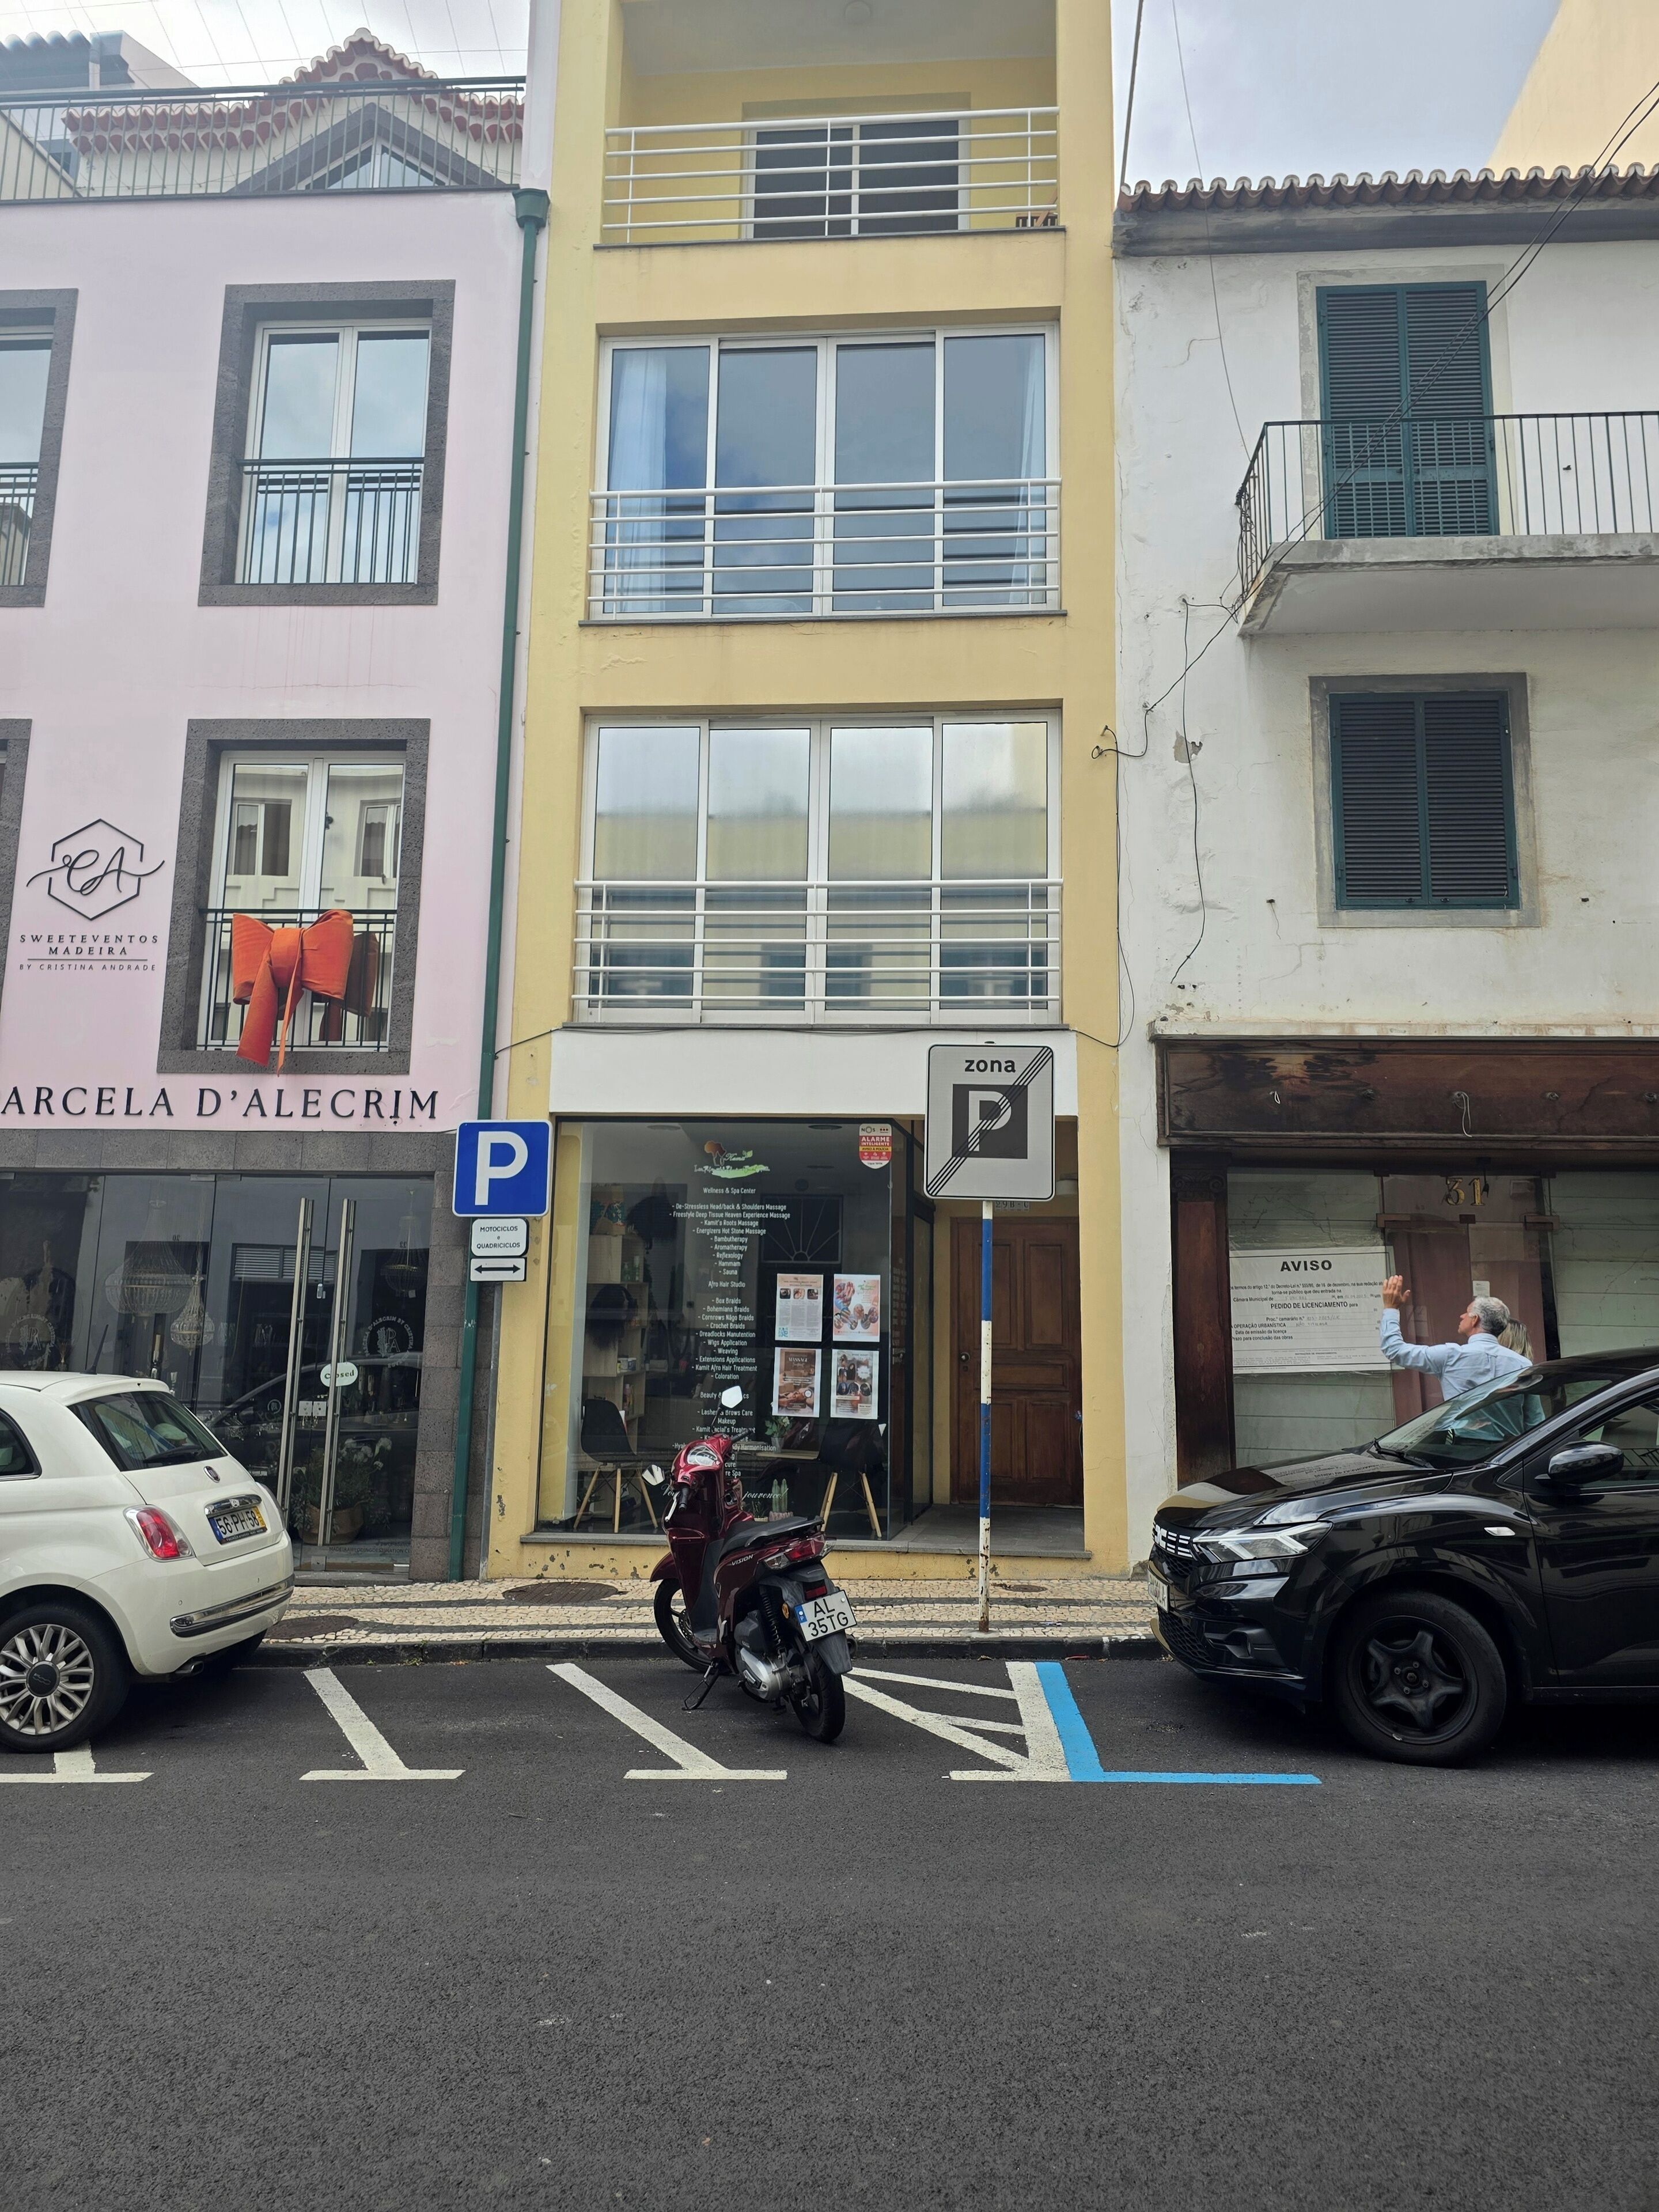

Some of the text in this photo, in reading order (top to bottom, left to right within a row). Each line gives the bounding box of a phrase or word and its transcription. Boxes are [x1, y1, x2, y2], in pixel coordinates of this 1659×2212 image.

[20, 934, 158, 944] SWEETEVENTOS
[48, 946, 128, 956] MADEIRA
[965, 1059, 1016, 1073] zona
[1, 1086, 438, 1119] ARCELA D'ALECRIM
[968, 1090, 1012, 1152] P
[475, 1131, 528, 1206] P
[1445, 1177, 1485, 1206] 31
[1280, 1260, 1332, 1272] AVISO
[708, 1281, 718, 1289] Afro
[324, 1370, 354, 1379] Cosed
[732, 1470, 741, 1478] Spa
[732, 1554, 753, 1566] VISION
[814, 1599, 835, 1618] AL
[808, 1612, 849, 1637] 35TG
